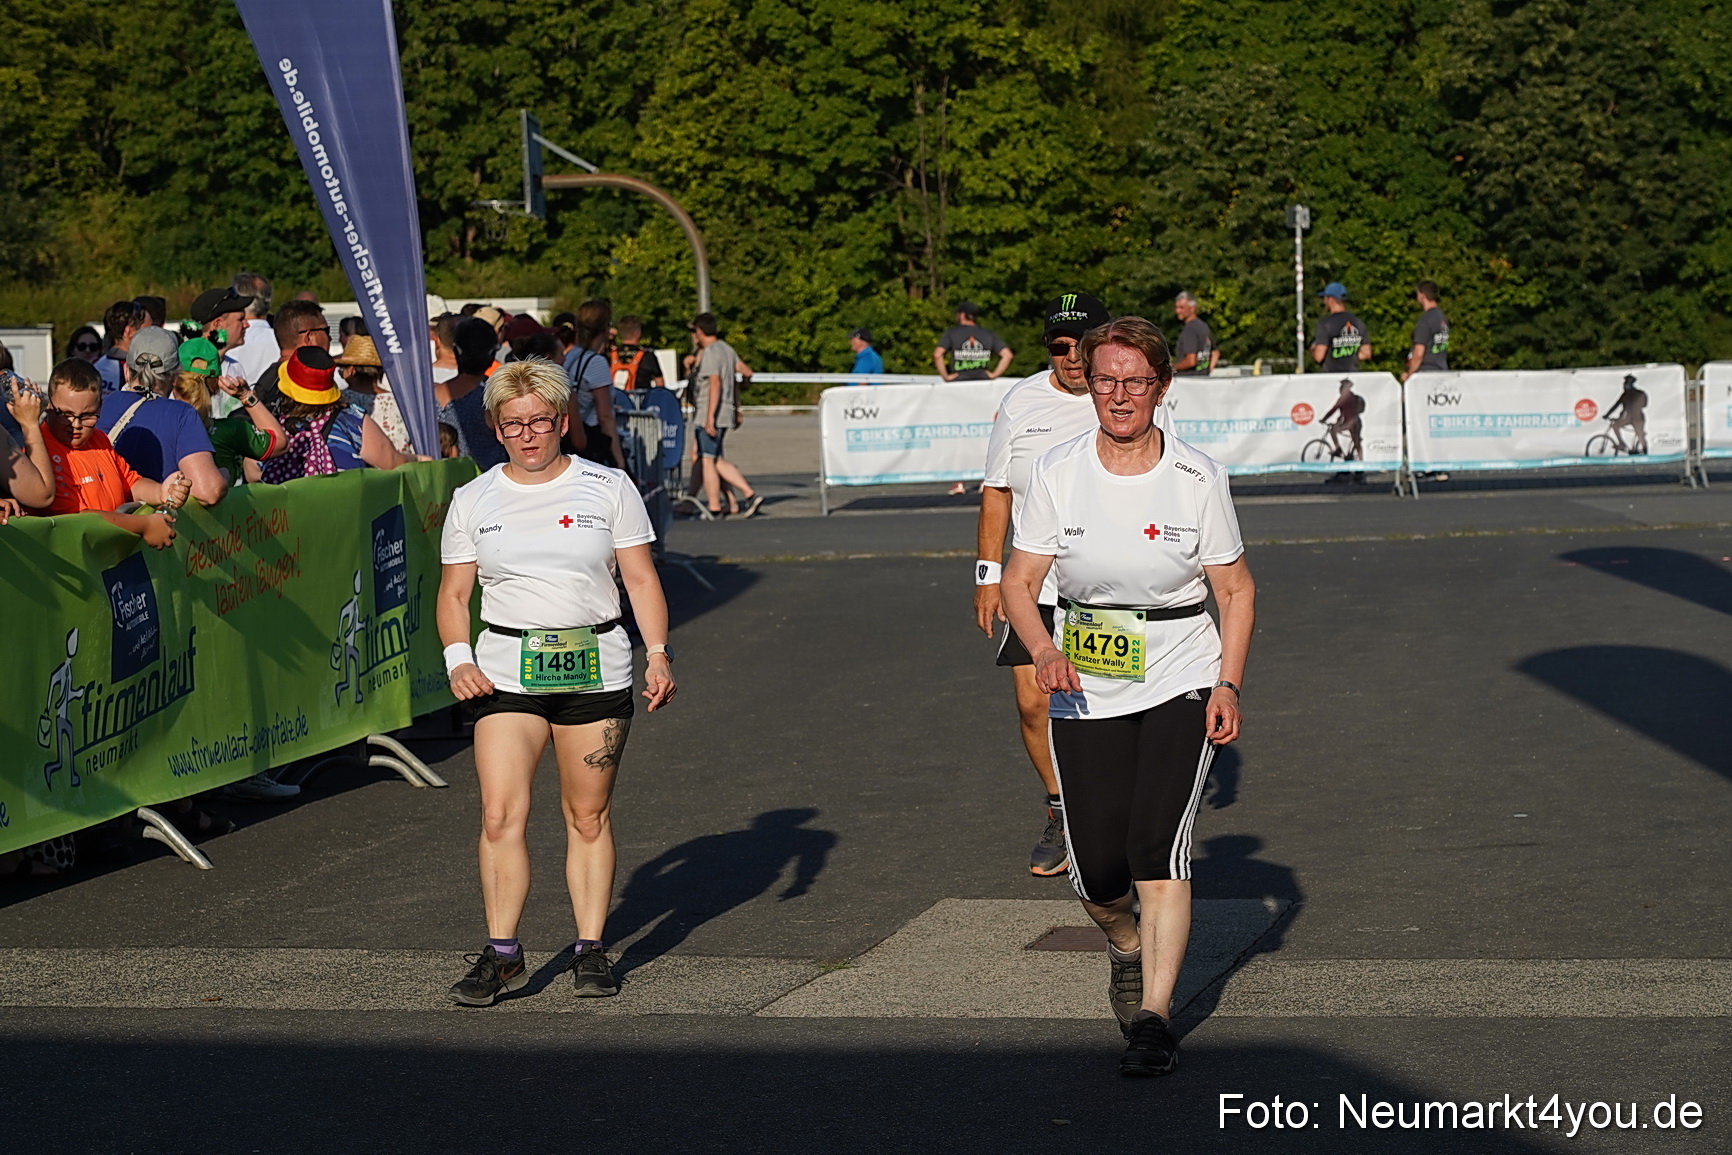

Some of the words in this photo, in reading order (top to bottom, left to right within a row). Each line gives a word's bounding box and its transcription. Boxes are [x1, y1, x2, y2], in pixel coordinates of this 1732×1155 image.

[1427, 394, 1462, 406] NOW
[844, 407, 879, 420] NOW
[1430, 415, 1481, 429] E-BIKES
[1484, 415, 1493, 427] &
[848, 429, 899, 442] E-BIKES
[902, 427, 911, 440] &
[581, 470, 607, 482] CRAFT
[1174, 461, 1201, 478] CRAFT
[479, 523, 503, 536] Mandy
[1064, 527, 1086, 538] Wally
[1164, 525, 1198, 534] Bayerisches
[186, 514, 243, 578] Gesunde
[245, 507, 289, 549] Firmen
[377, 539, 404, 562] Fischer
[215, 565, 253, 617] laufen
[255, 536, 301, 600] länger!
[118, 592, 147, 621] Fischer
[1072, 629, 1129, 657] 1479
[534, 649, 586, 672] 1481
[1074, 652, 1100, 665] Kratzer
[1102, 657, 1125, 668] Wally
[1131, 639, 1141, 671] 2022
[524, 658, 532, 680] RUN
[589, 651, 597, 680] 2022
[82, 625, 197, 745] firmenlauf
[536, 673, 561, 681] Hirche
[563, 672, 588, 681] Mandy
[85, 733, 139, 776] neumarkt
